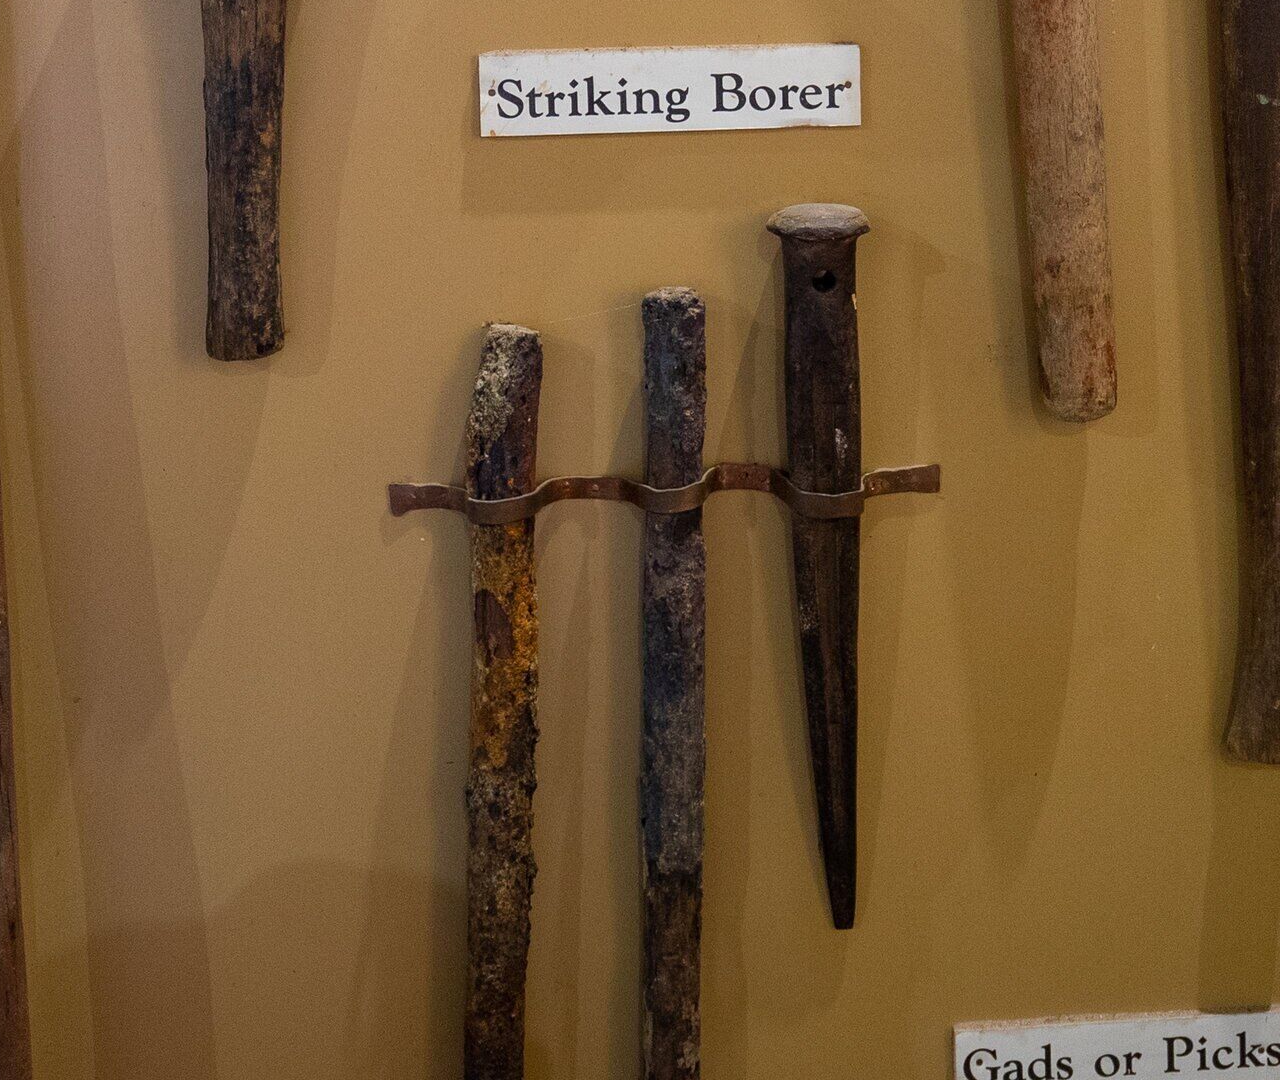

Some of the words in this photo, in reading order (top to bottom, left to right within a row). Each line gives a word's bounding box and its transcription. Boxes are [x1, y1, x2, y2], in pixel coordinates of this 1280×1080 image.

[496, 75, 690, 123] Striking
[710, 72, 845, 112] Borer
[963, 1043, 1074, 1080] Gads
[1094, 1050, 1143, 1077] or
